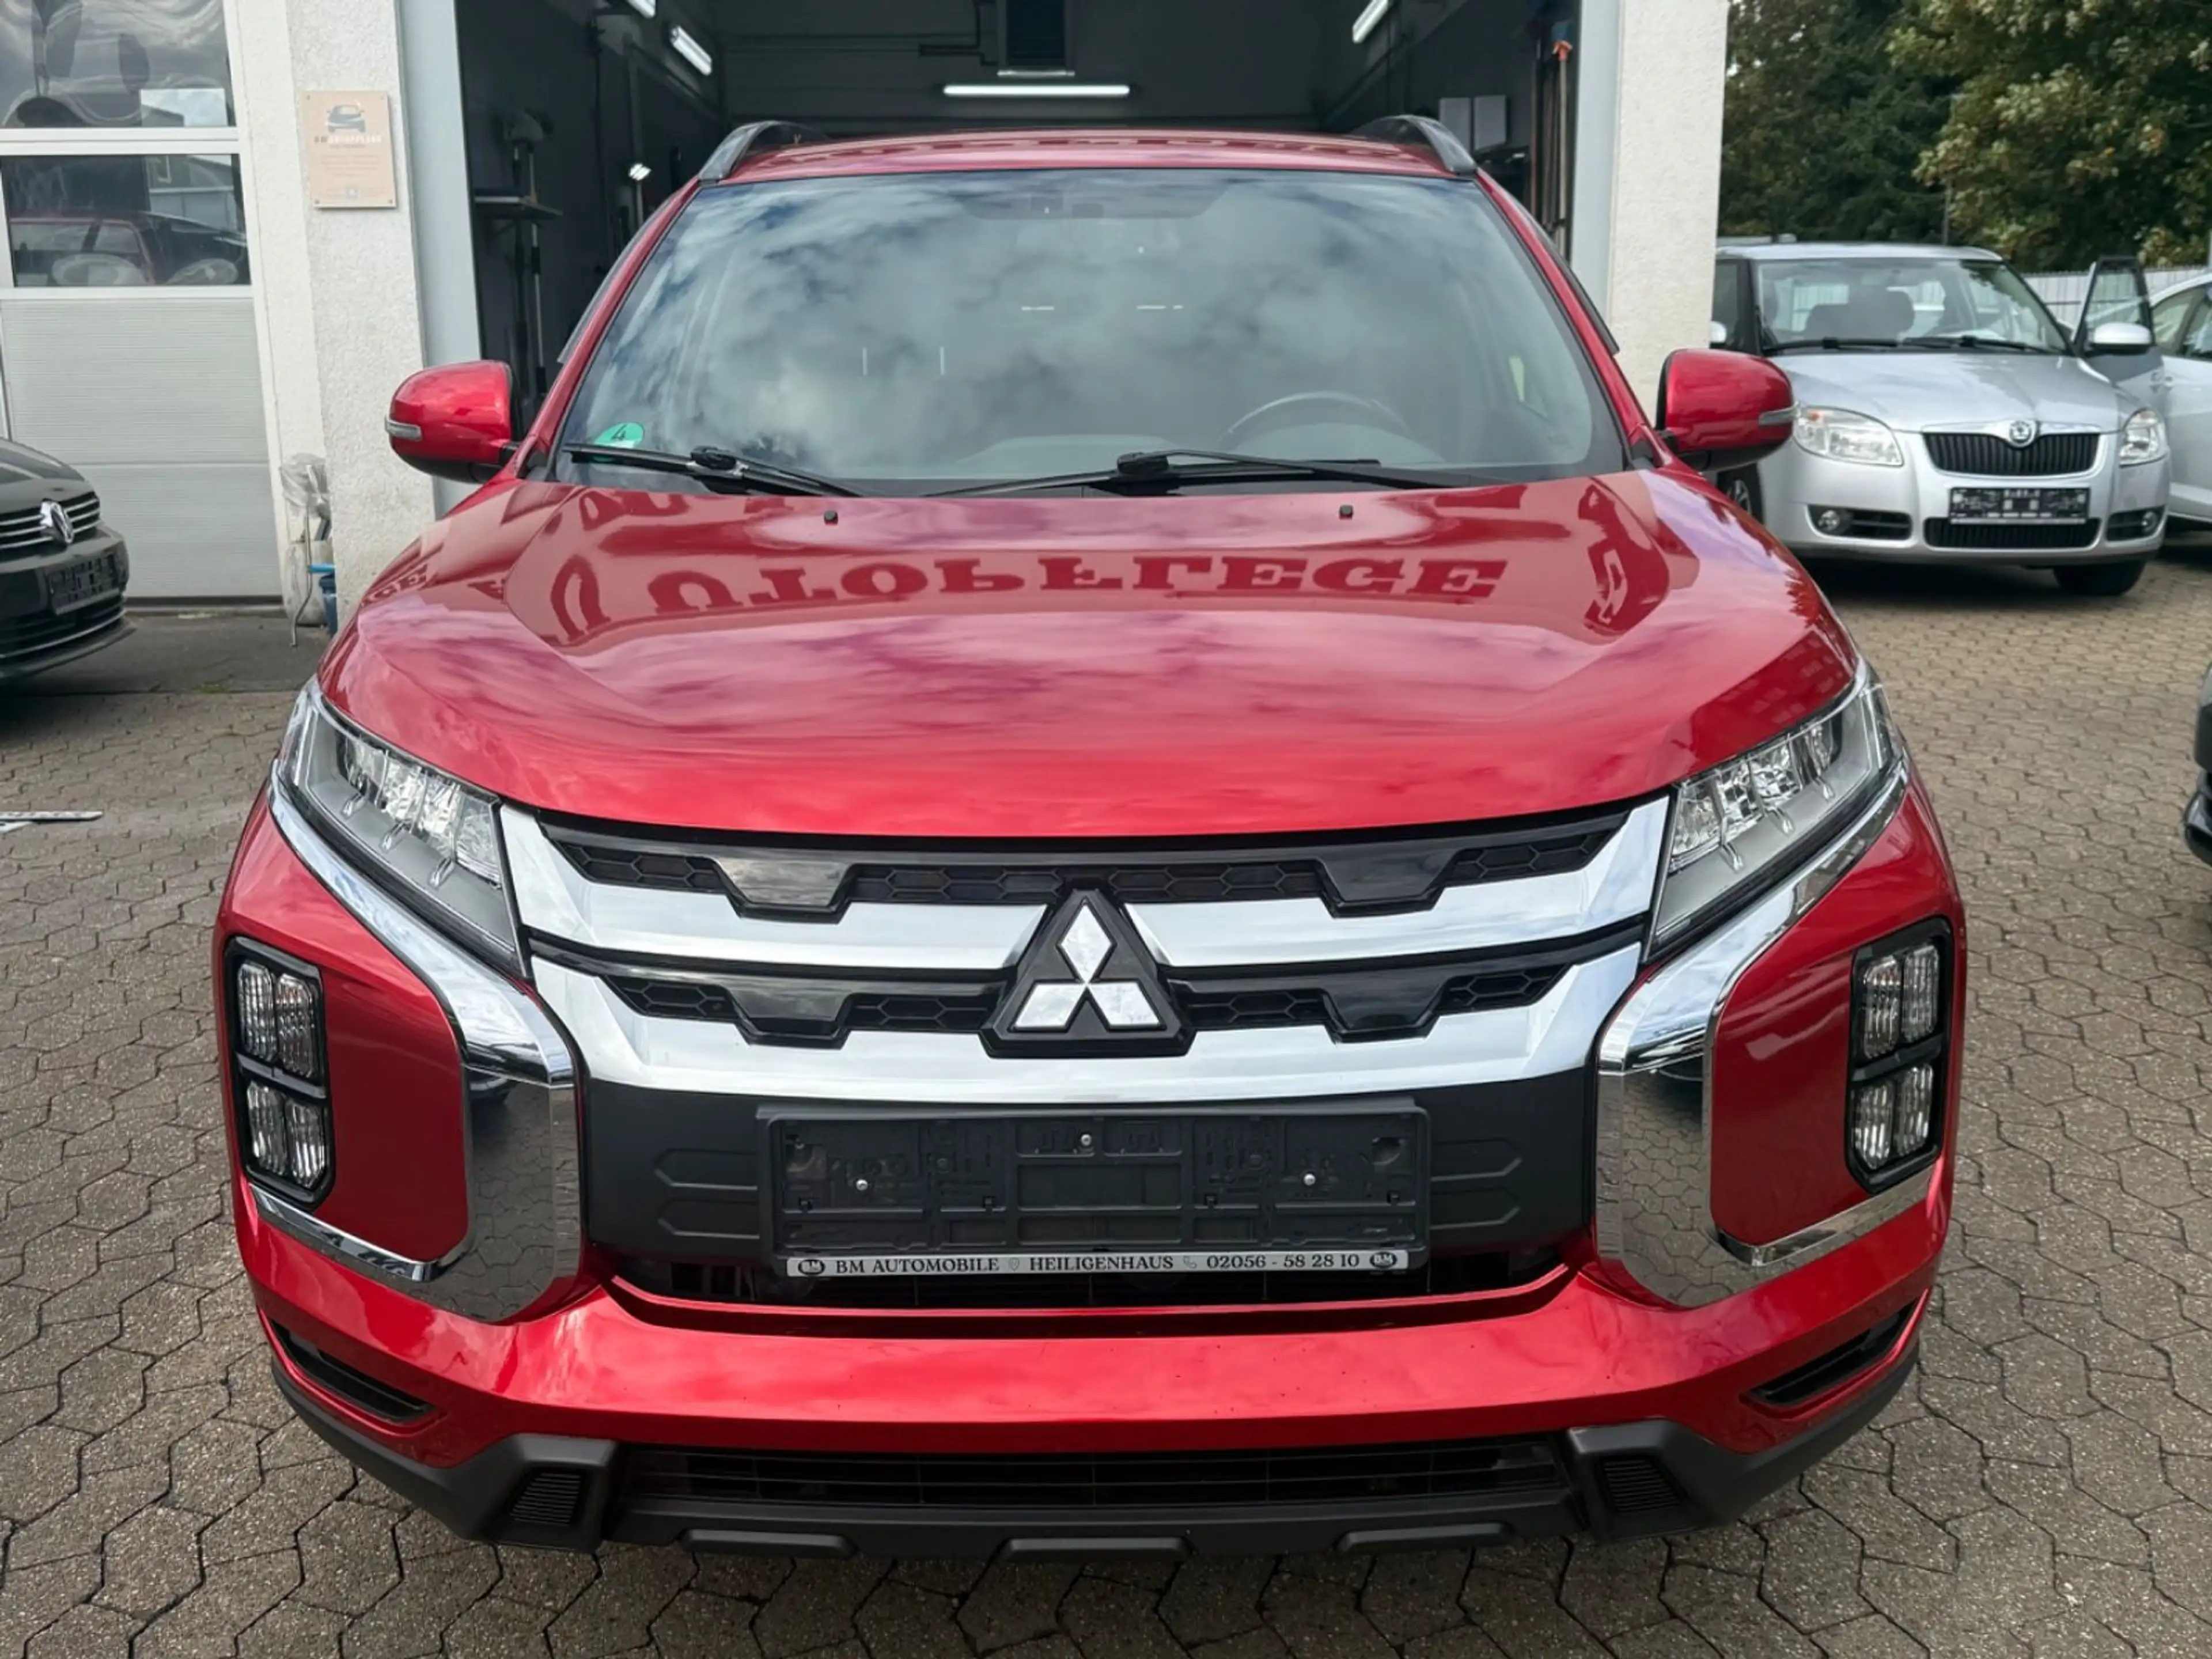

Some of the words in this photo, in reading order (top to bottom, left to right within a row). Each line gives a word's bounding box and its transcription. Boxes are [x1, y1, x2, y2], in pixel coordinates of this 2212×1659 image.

[836, 1259, 864, 1274] BM
[872, 1257, 1000, 1274] AUTOMOBILE
[1029, 1255, 1173, 1271] HEILIGENHAUS
[1206, 1254, 1267, 1268] 02056
[1283, 1253, 1306, 1268] 58
[1311, 1253, 1335, 1267] 28
[1340, 1253, 1360, 1267] 10
